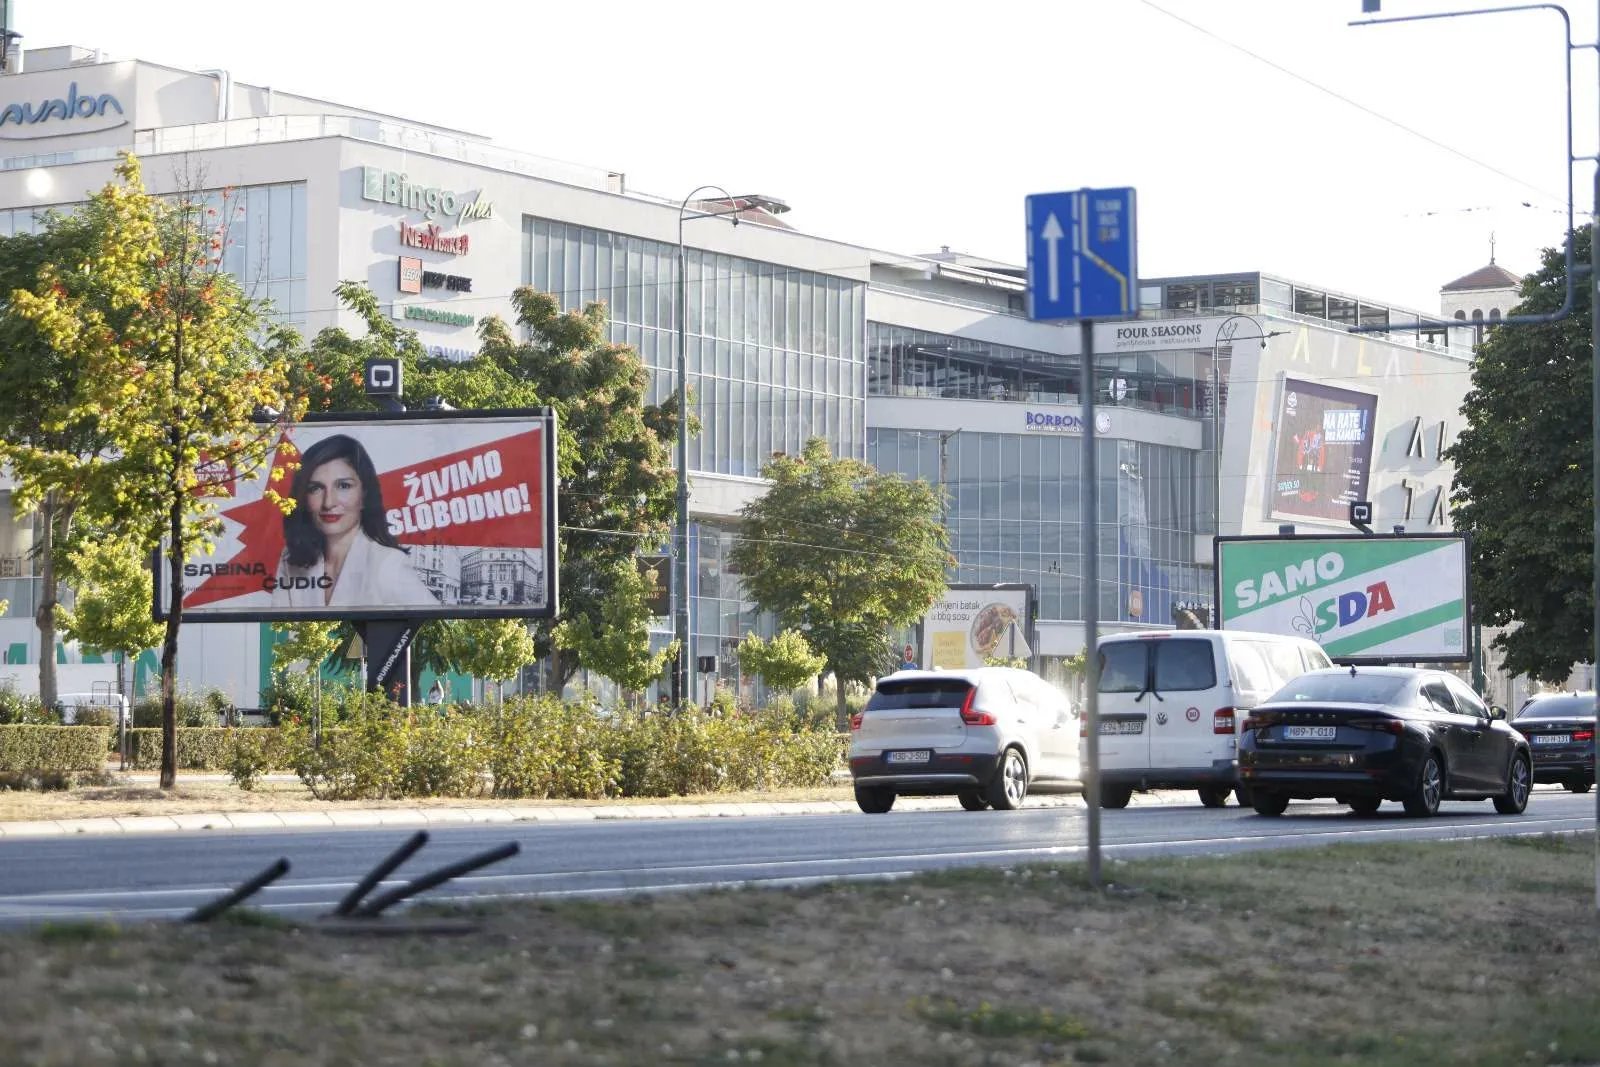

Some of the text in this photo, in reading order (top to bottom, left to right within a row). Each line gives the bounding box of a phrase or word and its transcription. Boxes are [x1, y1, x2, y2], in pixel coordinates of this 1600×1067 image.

[0, 81, 124, 126] avalon
[384, 173, 496, 228] Bingo plus
[1117, 324, 1202, 339] FOUR SEASONS
[403, 449, 502, 506] ŽIVIMO
[386, 482, 531, 536] SLOBODNO!
[184, 561, 268, 577] SABINA
[1235, 552, 1344, 609] SAMO
[1314, 580, 1395, 634] SDA
